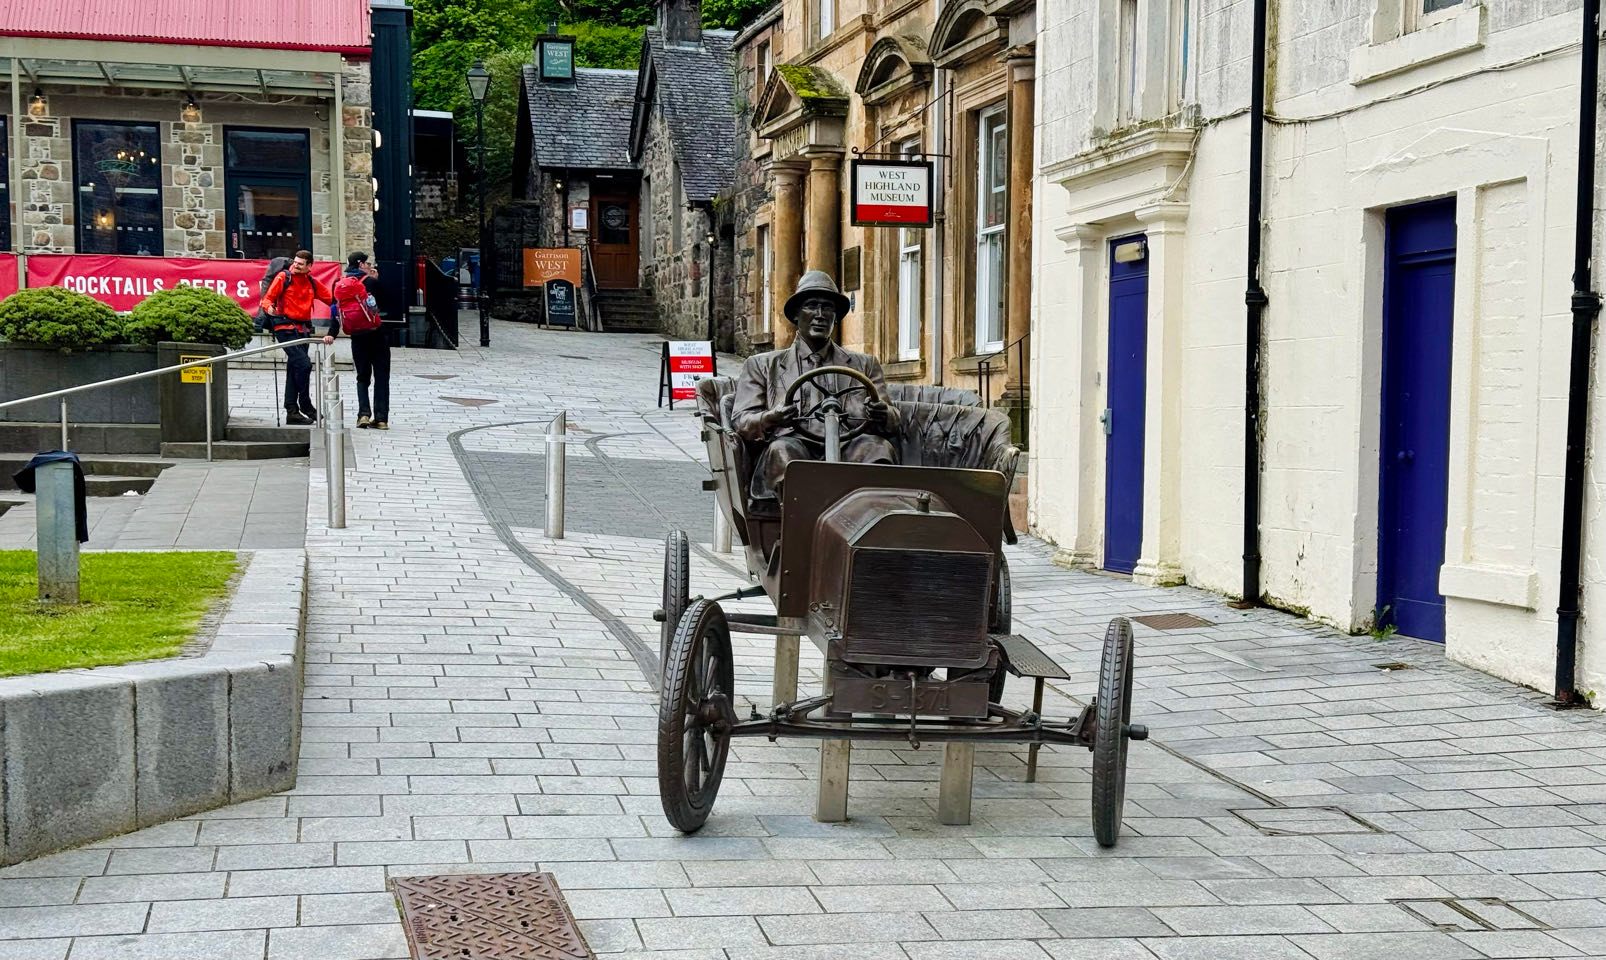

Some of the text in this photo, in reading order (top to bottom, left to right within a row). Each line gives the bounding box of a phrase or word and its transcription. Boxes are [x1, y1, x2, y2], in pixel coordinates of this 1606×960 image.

[879, 170, 907, 180] WEST
[865, 181, 921, 192] HIGHLAND
[870, 193, 915, 203] MUSEUM
[534, 250, 569, 259] Garrison
[535, 260, 569, 270] WEST
[236, 280, 250, 298] &
